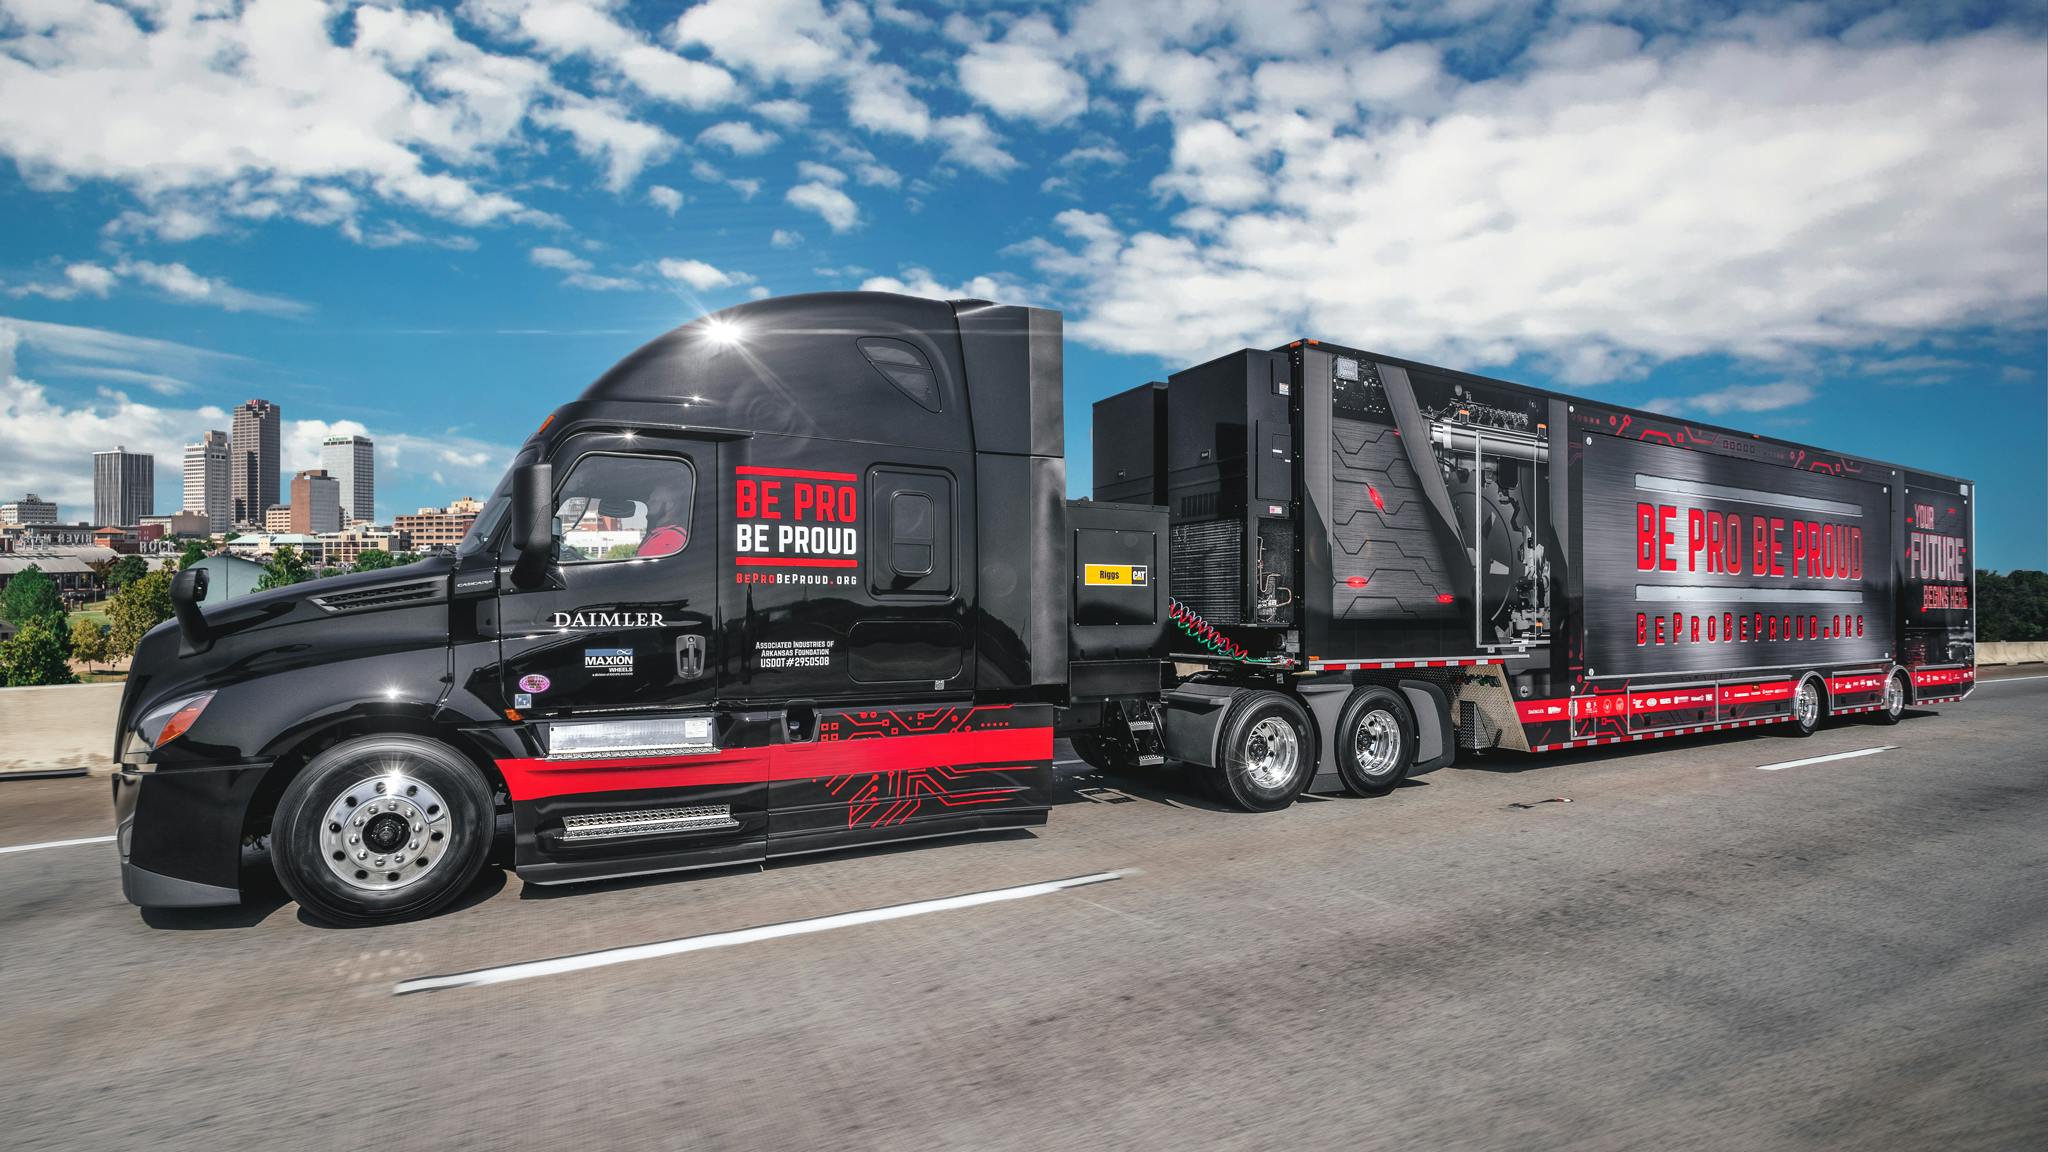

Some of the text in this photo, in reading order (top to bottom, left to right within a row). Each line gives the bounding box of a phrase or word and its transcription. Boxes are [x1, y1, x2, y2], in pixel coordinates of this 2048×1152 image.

[736, 479, 857, 523] BE PRO
[1914, 503, 1935, 529] YOUR
[140, 540, 176, 553] ROCK
[736, 524, 857, 555] BE PROUD
[1636, 502, 1863, 580] BE PRO BE PROUD
[1910, 532, 1964, 581] FUTURE
[1099, 570, 1146, 581] Riggs CAT
[553, 612, 667, 627] DAIMLER
[585, 656, 632, 666] MAXION
[760, 656, 829, 668] USDOT#2950508
